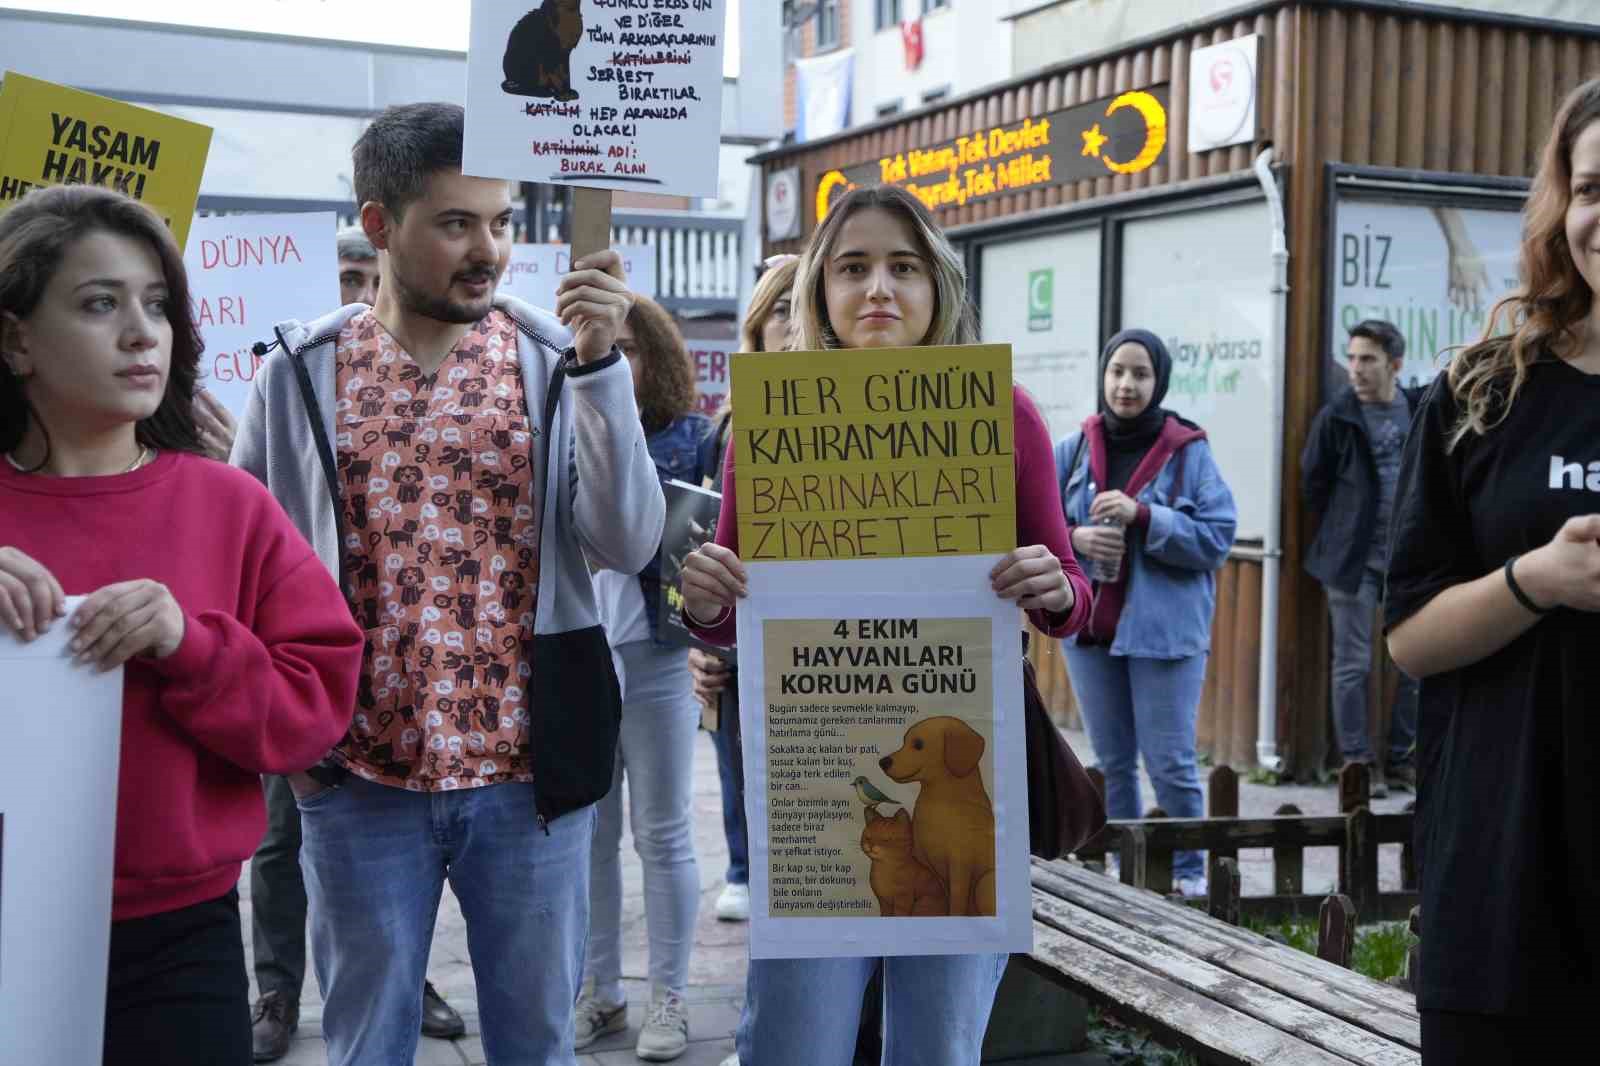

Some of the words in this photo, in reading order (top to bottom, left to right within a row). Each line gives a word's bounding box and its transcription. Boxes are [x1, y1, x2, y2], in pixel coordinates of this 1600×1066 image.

[614, 16, 632, 29] VE
[638, 12, 684, 28] DİĞER
[586, 24, 614, 44] TÜM
[586, 66, 654, 83] SERBEST
[590, 106, 618, 121] HEP
[624, 106, 688, 120] ARANIZDA
[51, 112, 160, 171] YAŞAM
[989, 118, 1051, 157] Devlet
[42, 149, 146, 199] HAKKI
[560, 159, 606, 173] BURAK
[614, 161, 646, 174] ALAN
[201, 235, 302, 269] DÜNYA
[1341, 223, 1392, 288] BİZ
[763, 376, 842, 416] HER
[864, 365, 996, 413] GÜNÜN
[749, 419, 958, 465] KAHRAMANI
[970, 418, 1013, 457] OL
[752, 466, 997, 514] BARINAKLARI
[833, 618, 850, 640] 4
[792, 645, 964, 668] HAYVANLARI
[781, 673, 893, 695] KORUMA
[902, 668, 977, 694] GÜNÜ
[800, 703, 830, 713] sadece
[832, 704, 873, 713] sevmekle
[820, 716, 856, 726] gereken
[769, 744, 805, 754] Sokakta
[819, 744, 843, 753] kalan
[845, 744, 858, 753] bir
[770, 758, 794, 767] susuz
[797, 757, 820, 766] kalan
[823, 757, 835, 766] bir
[803, 769, 820, 778] terk
[823, 768, 851, 778] edilen
[770, 781, 782, 791] bir
[771, 798, 795, 807] Onlar
[772, 822, 801, 832] sadece
[803, 822, 825, 832] biraz
[772, 835, 817, 844] merhamet
[772, 863, 785, 872] Bir
[787, 863, 803, 874] kap
[805, 865, 818, 873] su,
[820, 863, 833, 872] bir
[835, 863, 852, 874] kap
[805, 875, 817, 885] bir
[773, 888, 789, 897] bile
